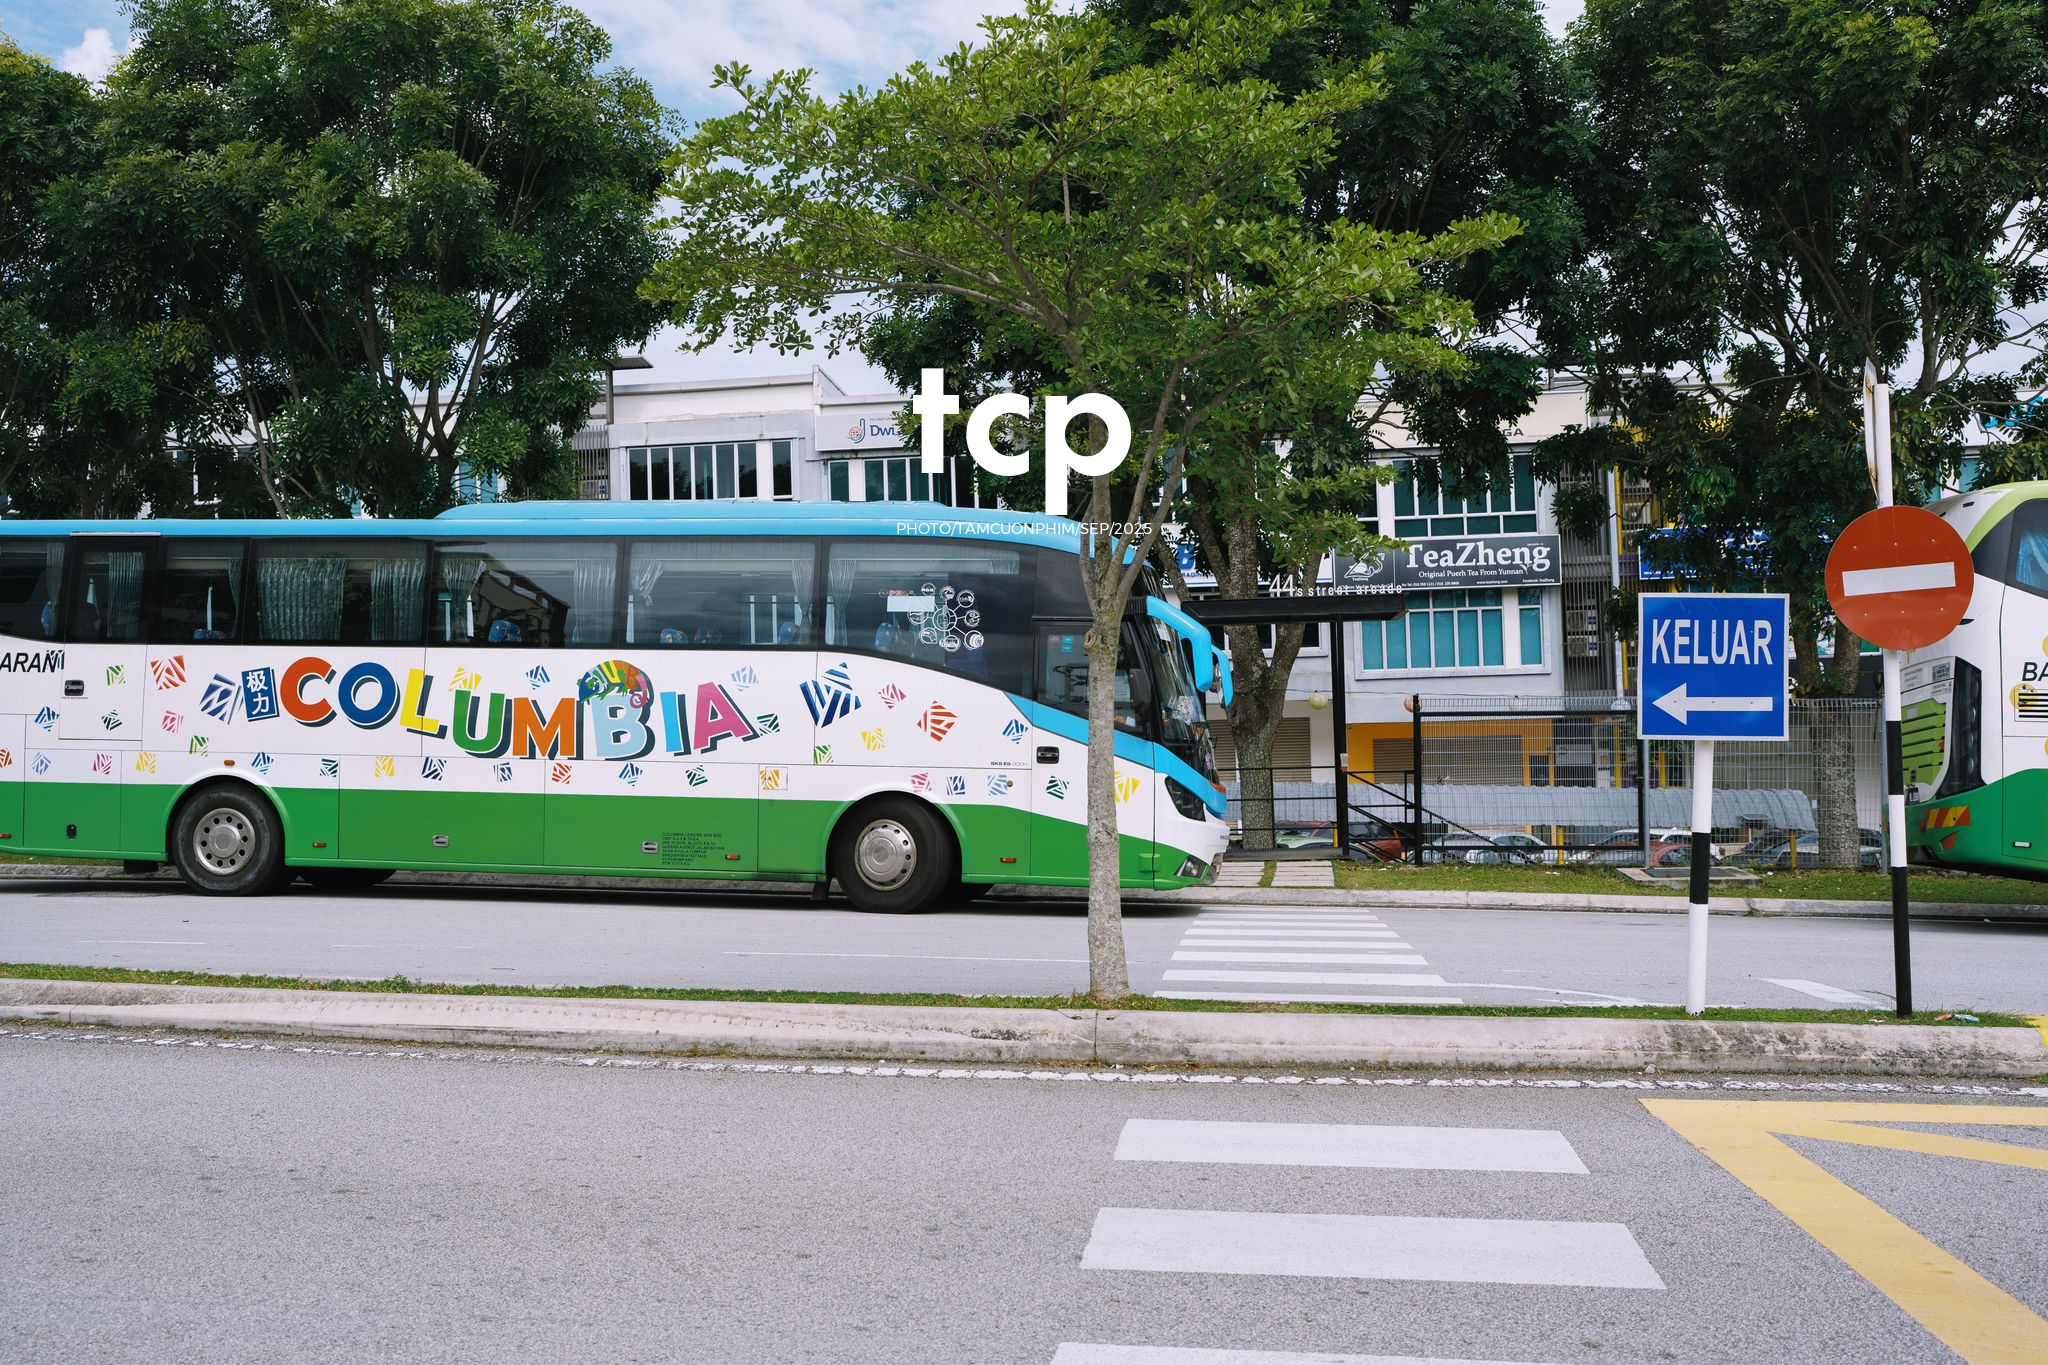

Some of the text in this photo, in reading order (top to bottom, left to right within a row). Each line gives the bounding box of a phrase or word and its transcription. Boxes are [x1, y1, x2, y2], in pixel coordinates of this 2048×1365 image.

[1406, 541, 1551, 572] TeaZheng
[1418, 567, 1524, 579] Original Puerh Tea From Yunnan
[1307, 584, 1350, 597] street
[1652, 619, 1773, 664] KELUAR
[246, 670, 270, 716] 极力
[280, 656, 757, 760] COLUMBIA
